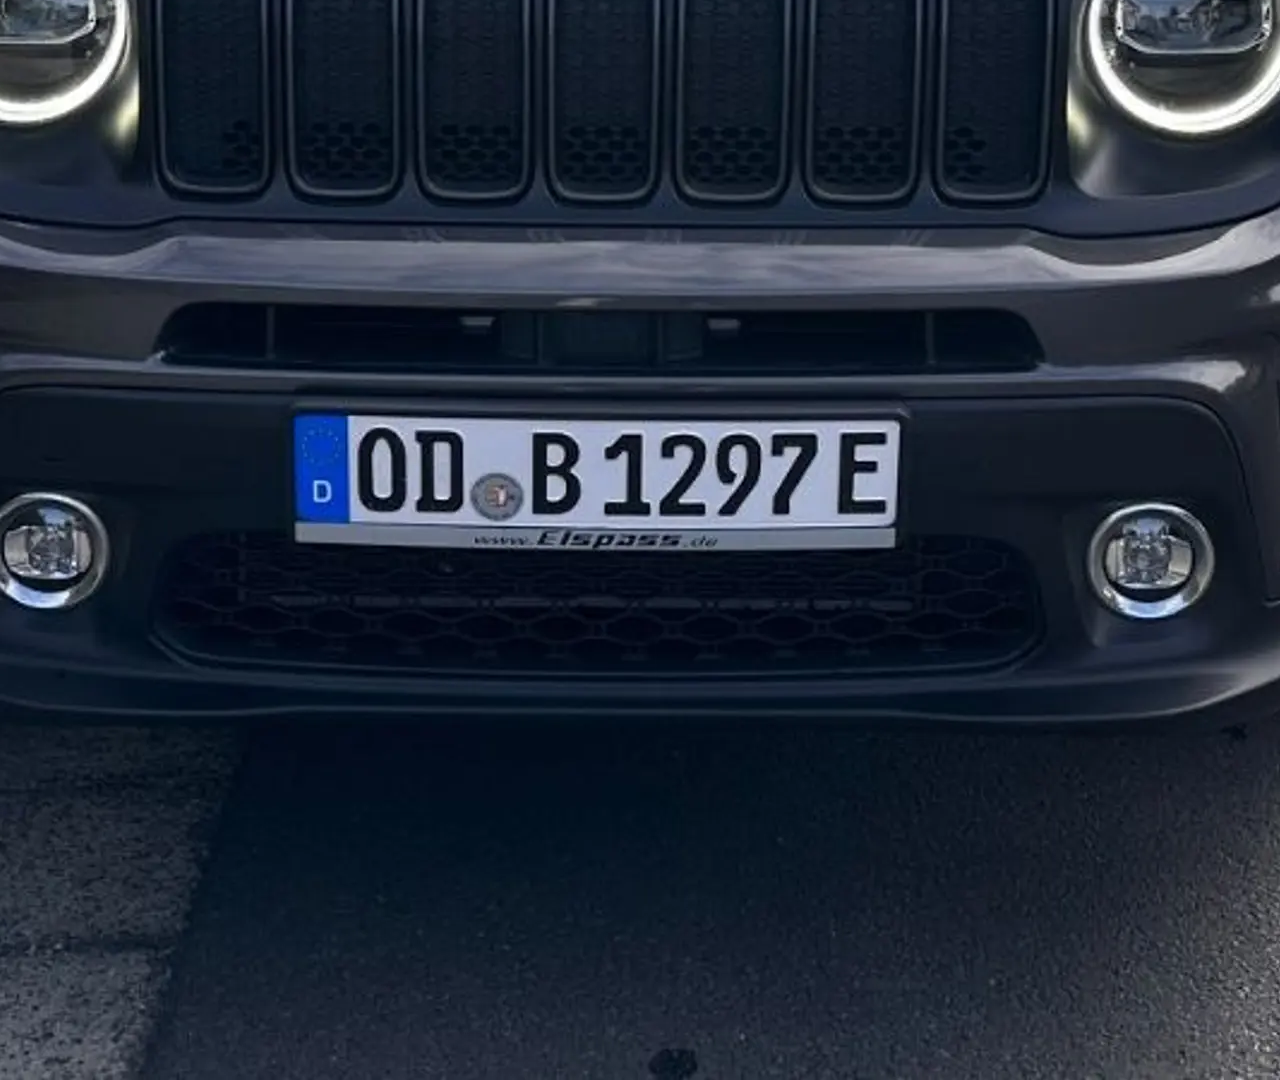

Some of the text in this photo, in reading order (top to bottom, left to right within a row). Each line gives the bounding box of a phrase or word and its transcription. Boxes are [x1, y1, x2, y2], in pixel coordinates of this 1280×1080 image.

[356, 426, 465, 513] OD
[311, 479, 332, 503] D
[473, 528, 719, 550] www.Elspass.de
